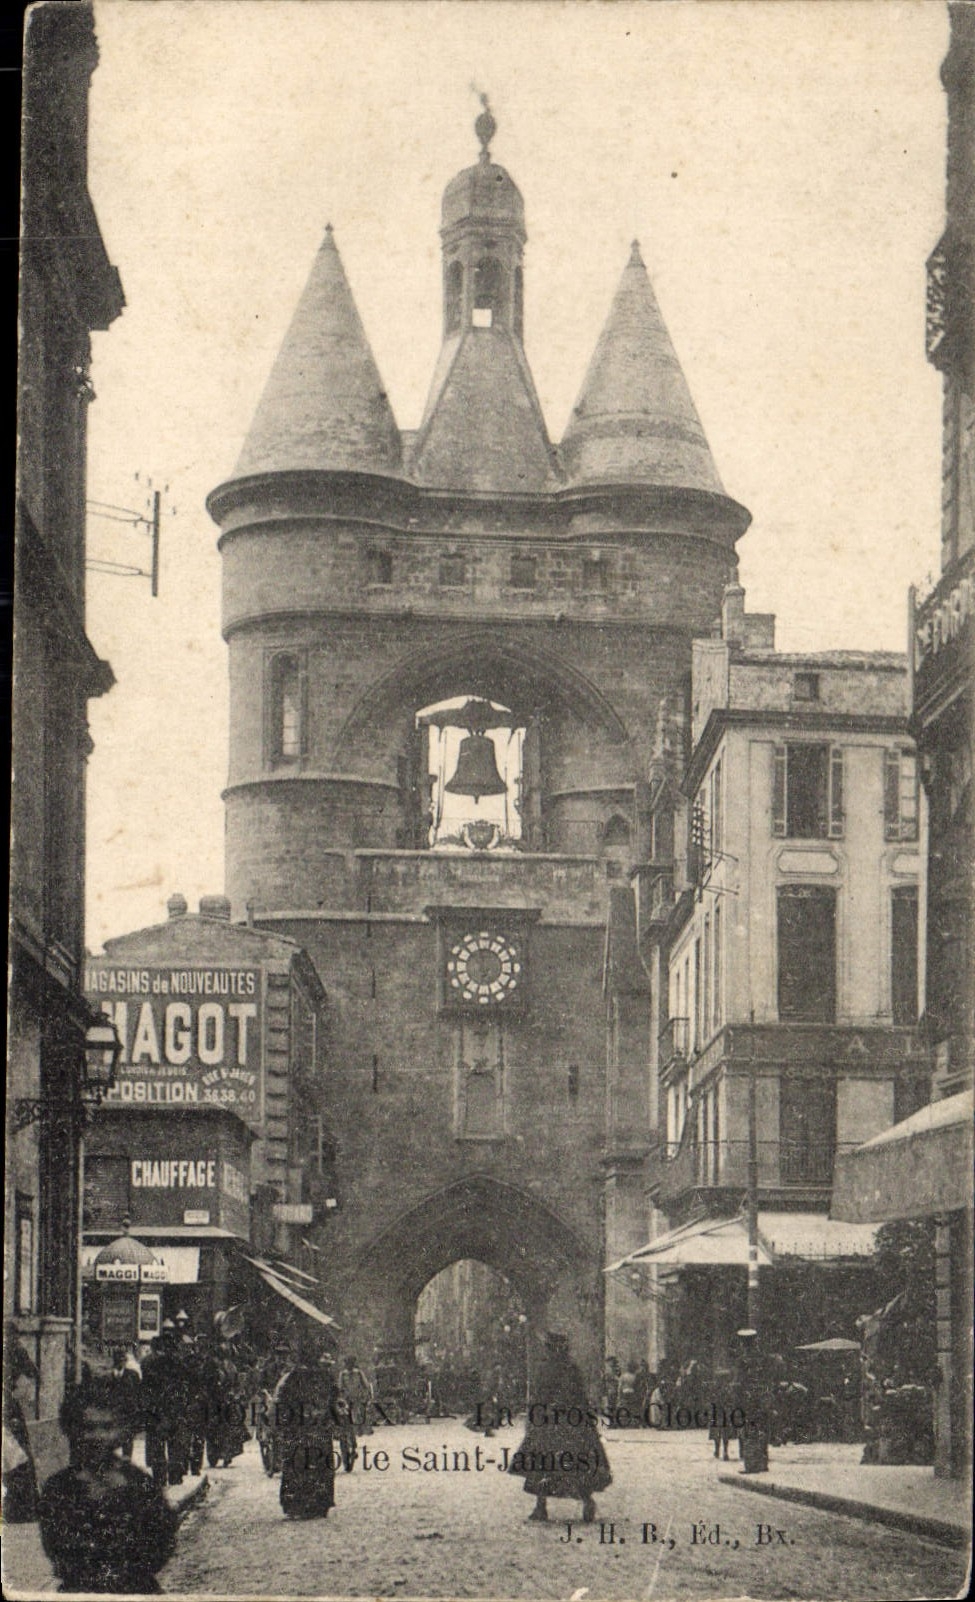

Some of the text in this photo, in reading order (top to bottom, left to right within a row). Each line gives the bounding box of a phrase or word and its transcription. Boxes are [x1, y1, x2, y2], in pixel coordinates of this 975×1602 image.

[153, 974, 168, 993] de
[131, 1160, 216, 1187] CHAUFFAGE
[98, 1269, 137, 1280] MAGGI
